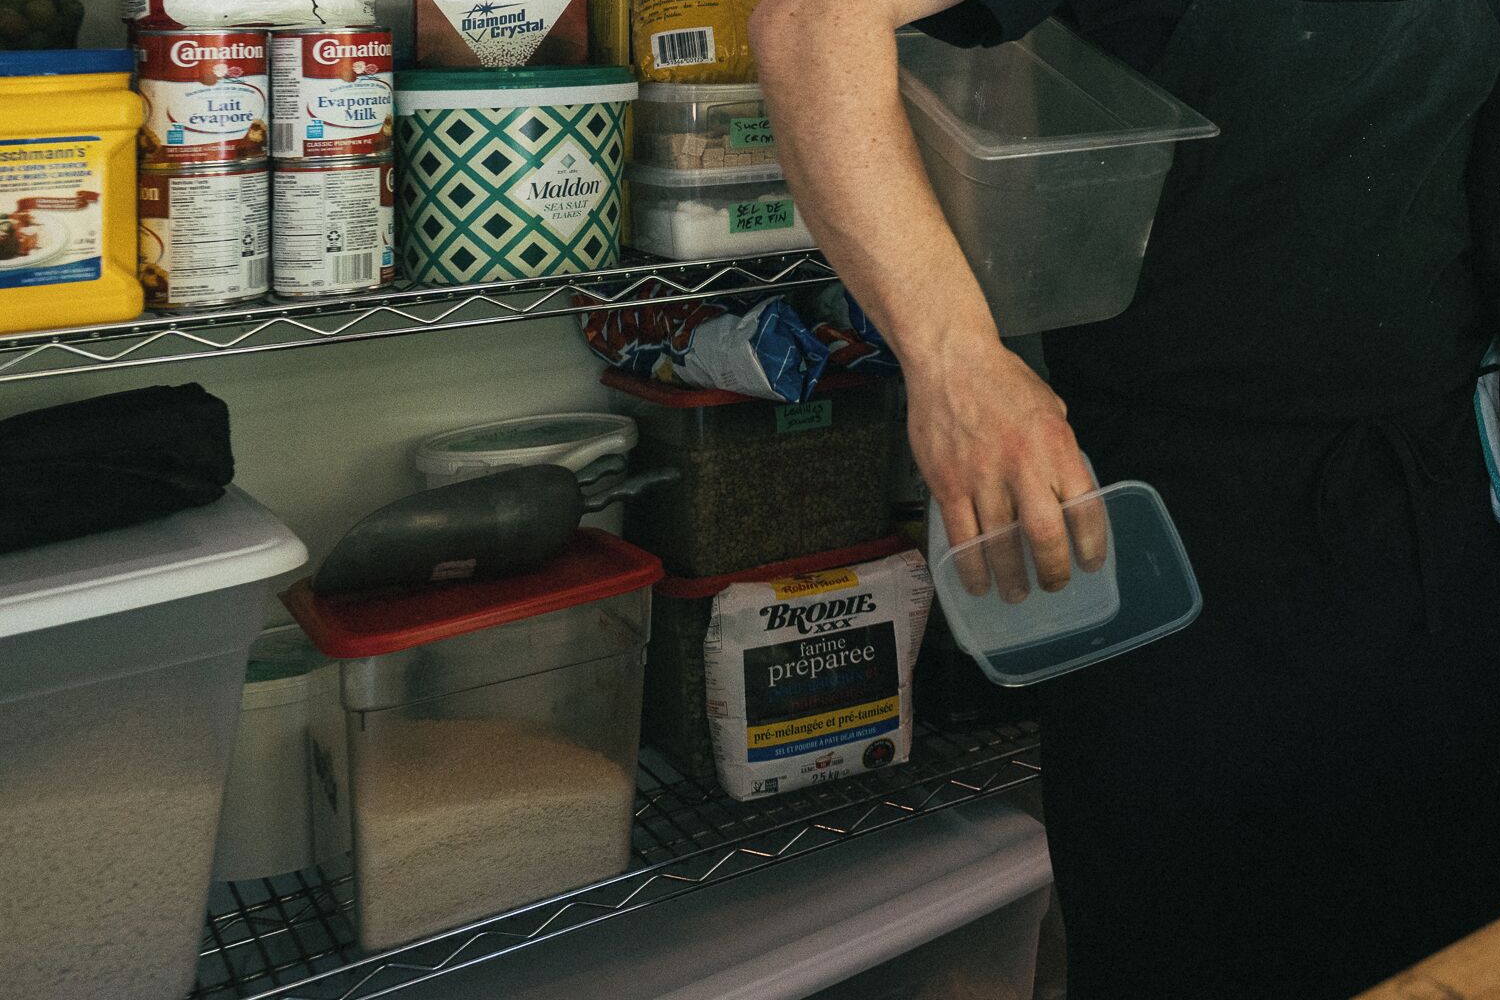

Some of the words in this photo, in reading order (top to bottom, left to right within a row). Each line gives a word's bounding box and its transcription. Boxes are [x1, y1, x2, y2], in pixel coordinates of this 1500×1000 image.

[461, 9, 526, 32] Diamond
[490, 18, 544, 39] Crystal
[170, 40, 264, 68] Carnation
[313, 39, 392, 65] Carnation
[208, 99, 241, 112] Lait
[317, 91, 392, 110] Evaporated
[189, 110, 254, 127] évaporé
[344, 107, 377, 121] Milk
[735, 120, 770, 131] Sucre
[334, 139, 362, 147] PUMPKIN
[526, 177, 600, 201] Maldon
[543, 202, 564, 212] SEA
[566, 200, 588, 210] SALT
[552, 211, 582, 220] FLAKES
[737, 203, 759, 218] SEL
[766, 202, 784, 213] DE
[737, 215, 763, 230] MER
[768, 212, 787, 224] FIN
[782, 581, 816, 594] Robin
[817, 574, 850, 590] Hood
[759, 593, 877, 635] BRODIE
[800, 636, 847, 657] farine
[753, 719, 824, 744] pré-mélangée
[826, 718, 836, 728] et
[838, 703, 894, 726] pré-tamisée
[775, 747, 785, 756] SEL
[786, 746, 795, 755] ET
[795, 740, 818, 754] POUDRE
[855, 726, 876, 740] INCLUS
